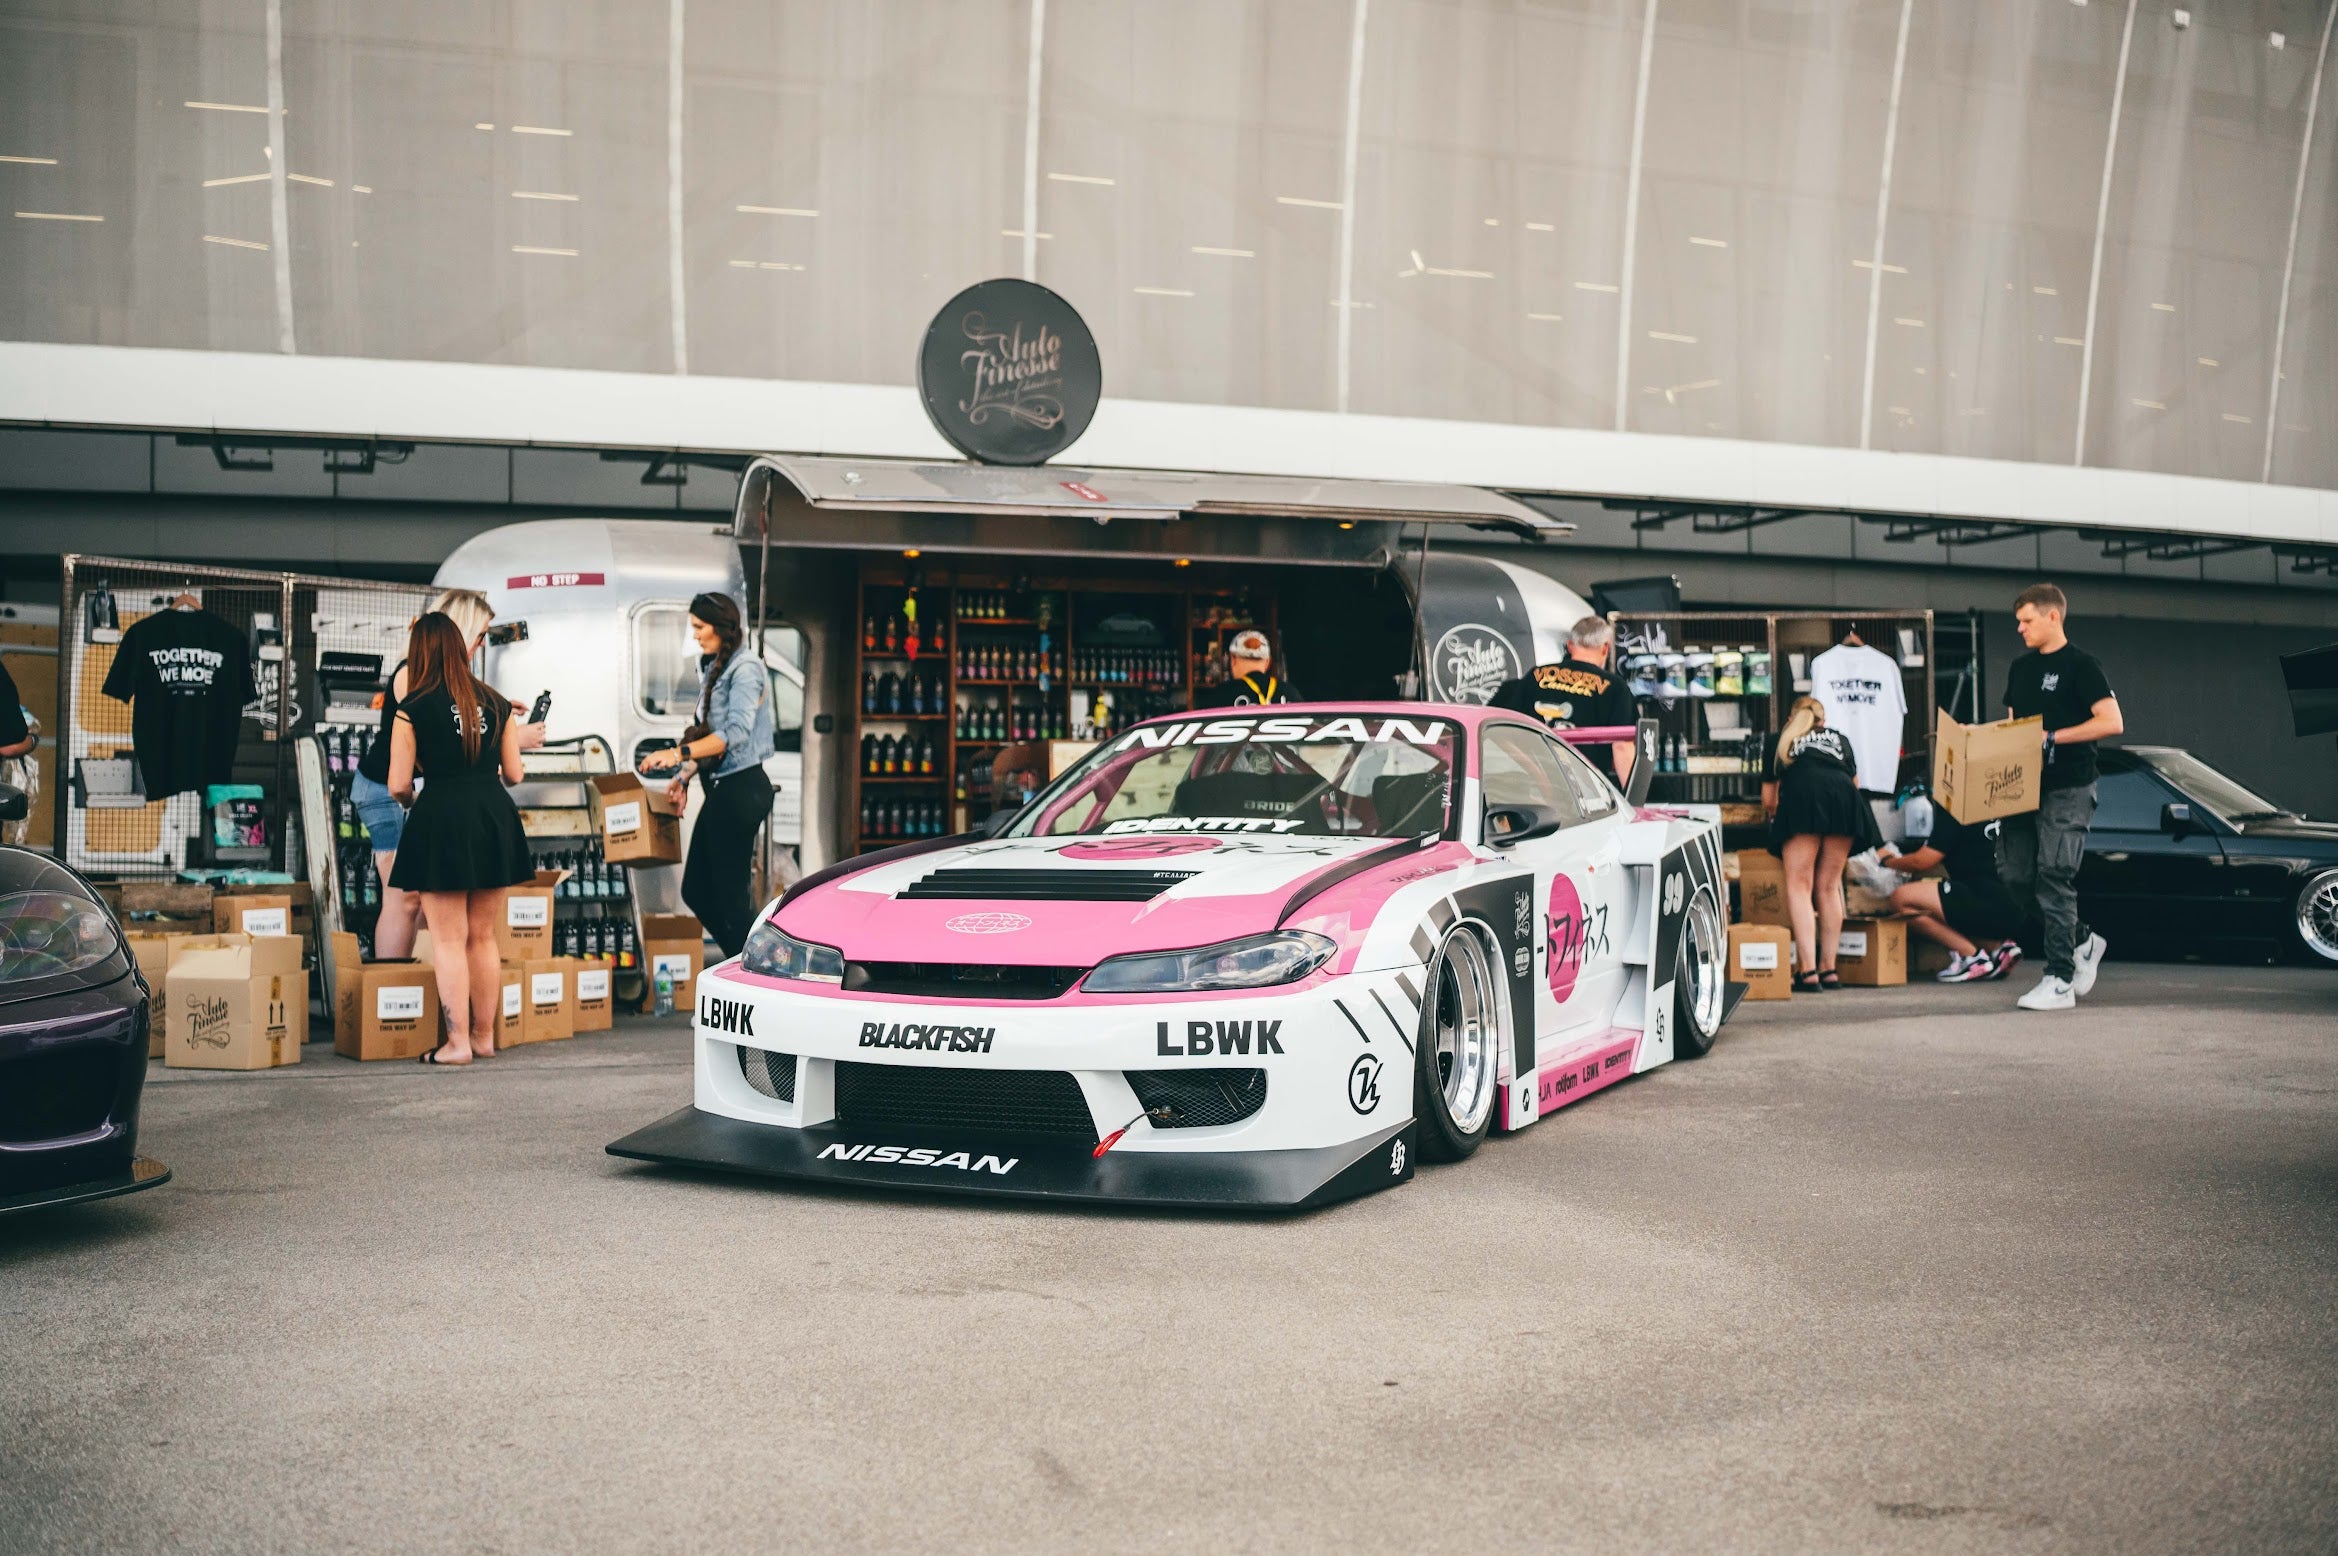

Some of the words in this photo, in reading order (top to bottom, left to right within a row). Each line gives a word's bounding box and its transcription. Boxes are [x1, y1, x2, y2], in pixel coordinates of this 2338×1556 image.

[531, 575, 547, 587] NO
[552, 573, 580, 586] STEP
[159, 667, 179, 683] WE
[1533, 666, 1611, 694] VOSSEN
[1114, 718, 1445, 751] NISSAN
[1102, 816, 1304, 834] IDENTITY
[1663, 871, 1684, 916] 99
[701, 995, 754, 1036] LBWK
[859, 1022, 995, 1053] BLACKFISH
[1157, 1020, 1285, 1056] LBWK
[1582, 1062, 1599, 1083] LBWK
[1604, 1050, 1632, 1069] IDENTITY
[816, 1143, 1019, 1175] NISSAN
